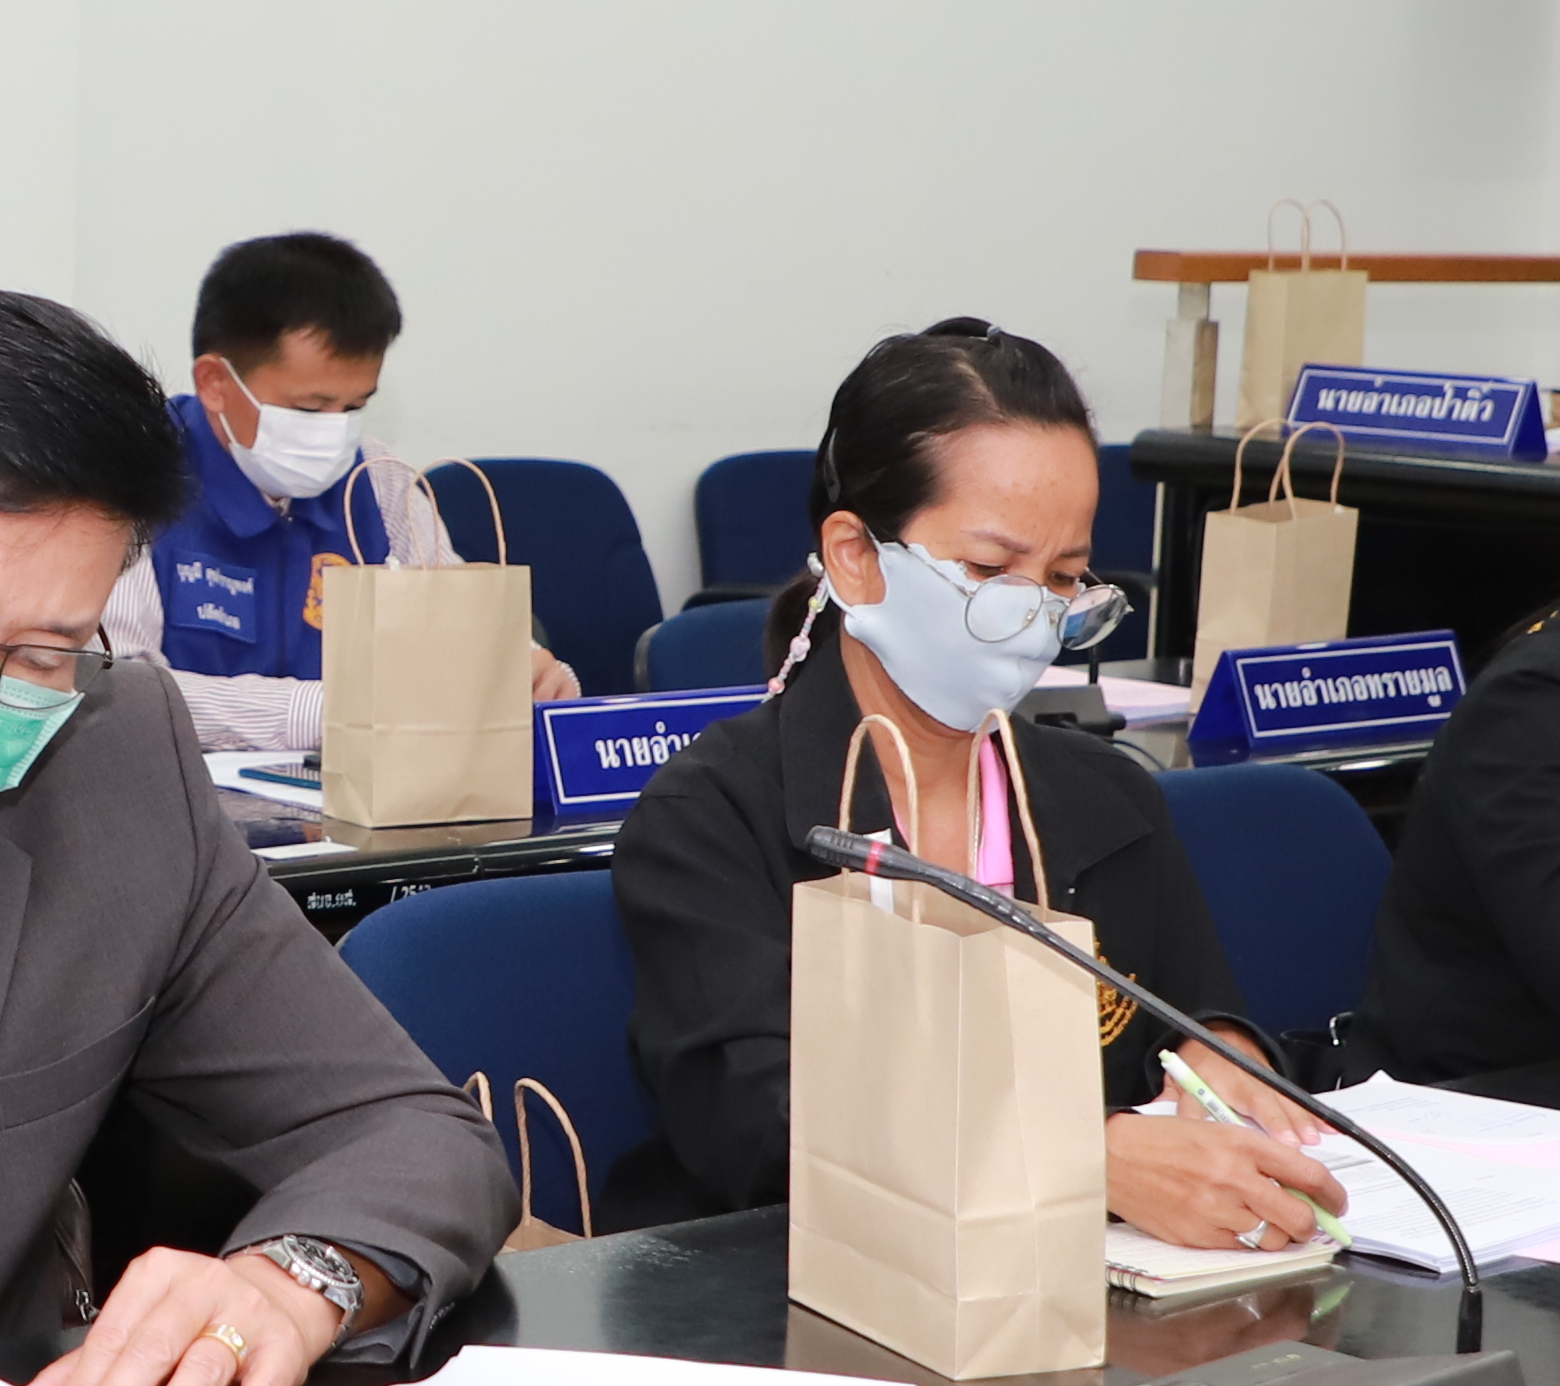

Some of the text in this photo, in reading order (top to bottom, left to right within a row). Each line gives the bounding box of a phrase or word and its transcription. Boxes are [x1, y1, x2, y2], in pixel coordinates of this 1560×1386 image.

[1317, 376, 1495, 422] นายอำเภอป่าติ้ว
[1254, 666, 1453, 709] นายอำเภอทรายมูล
